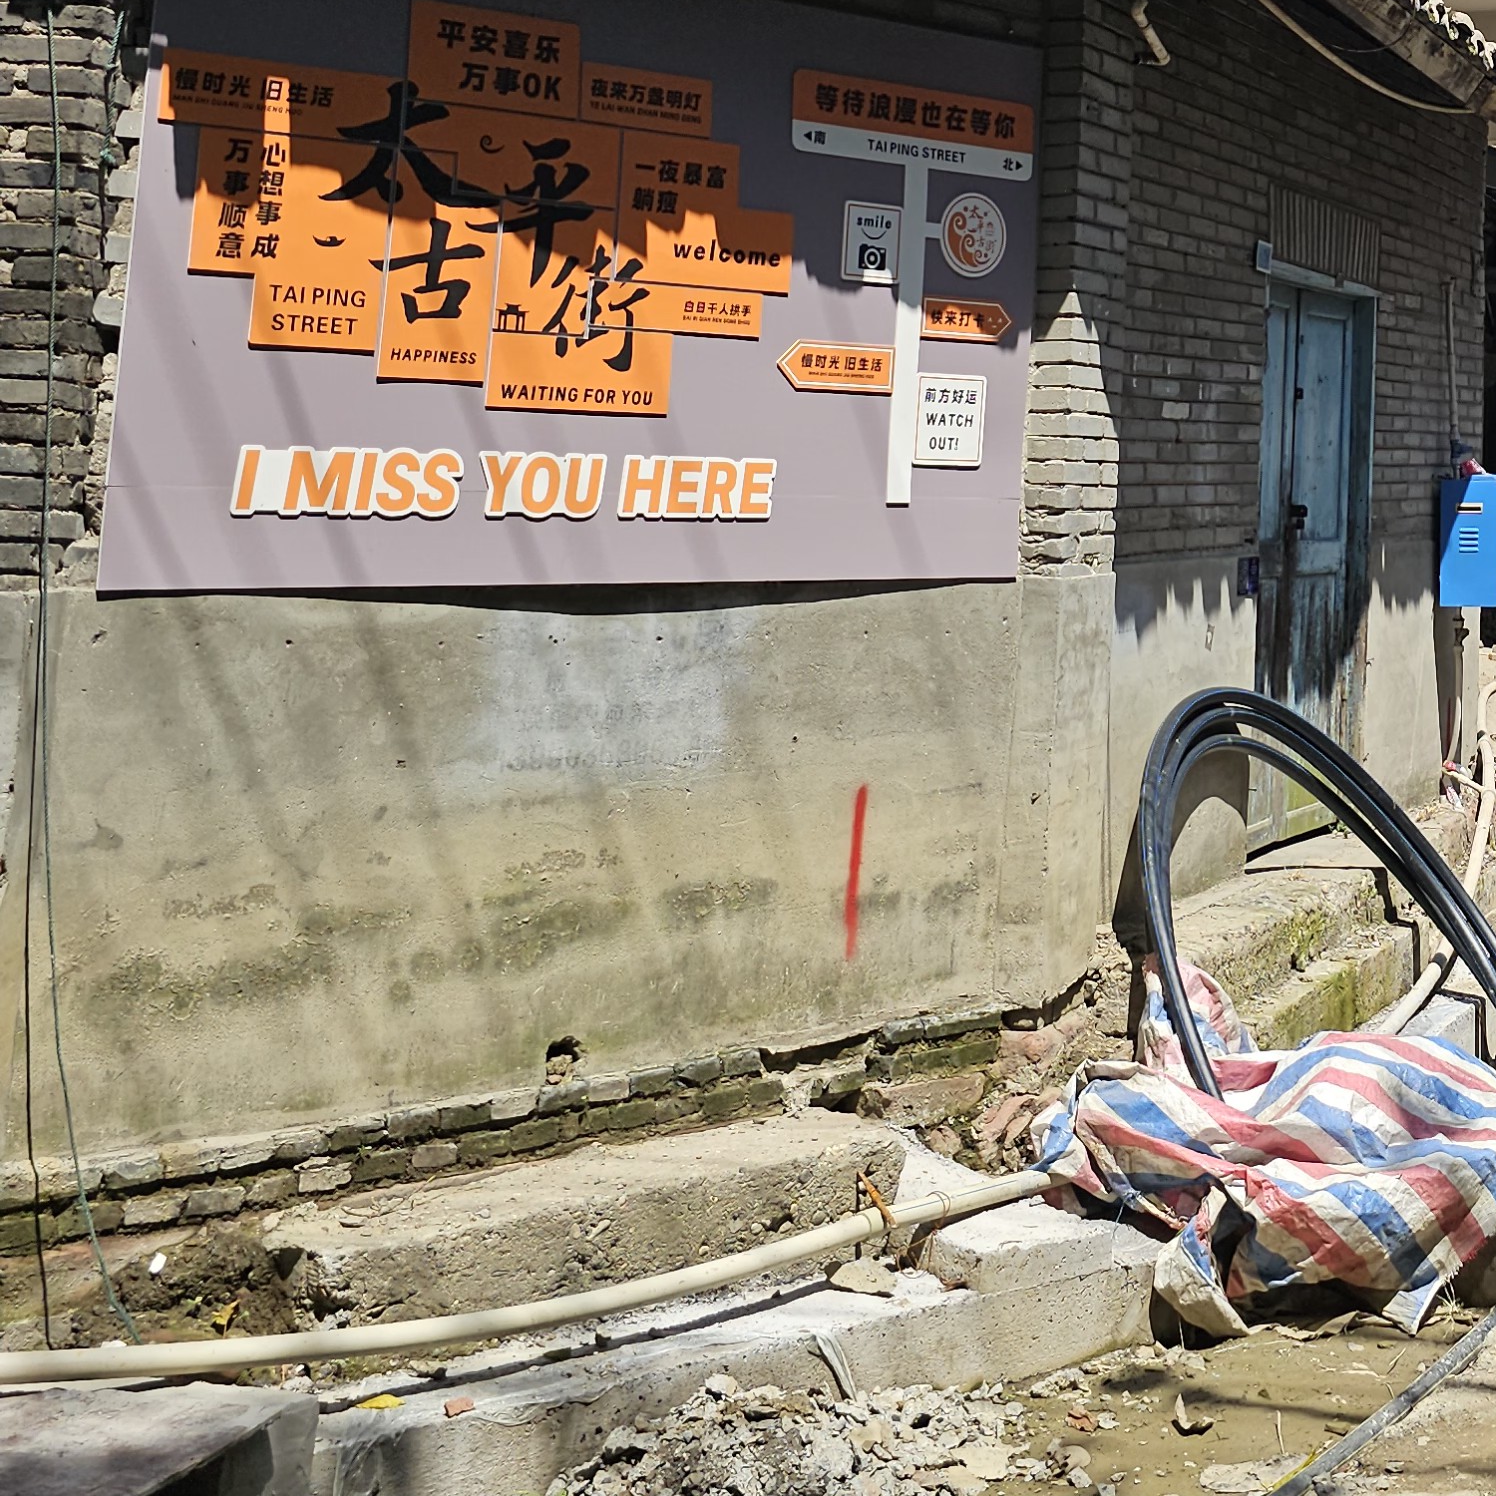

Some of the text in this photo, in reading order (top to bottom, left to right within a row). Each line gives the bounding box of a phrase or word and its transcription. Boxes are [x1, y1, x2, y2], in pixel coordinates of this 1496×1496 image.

[436, 18, 561, 65] 平安喜乐
[459, 61, 562, 102] 万事OK
[591, 78, 702, 112] 夜来万盏明灯
[816, 83, 1016, 140] 等待浪漫也在等你
[814, 130, 826, 145] 南
[922, 147, 966, 164] STREET
[1002, 157, 1013, 171] 北
[635, 159, 727, 189] 一夜暴富
[215, 138, 253, 259] 万事顺意
[251, 142, 286, 259] 心想事成
[631, 186, 679, 215] 躺瘦
[857, 215, 892, 230] smile
[674, 239, 781, 267] welcome
[271, 313, 358, 335] STREET
[930, 308, 985, 328] 快来打卡
[390, 347, 477, 365] HAPPINESS
[501, 384, 653, 406] WAITING FOR YOU
[924, 387, 977, 404] 前方好运
[926, 412, 974, 427] WATCH
[929, 436, 959, 451] OUT!
[234, 448, 776, 516] I MISS YOU HERE
